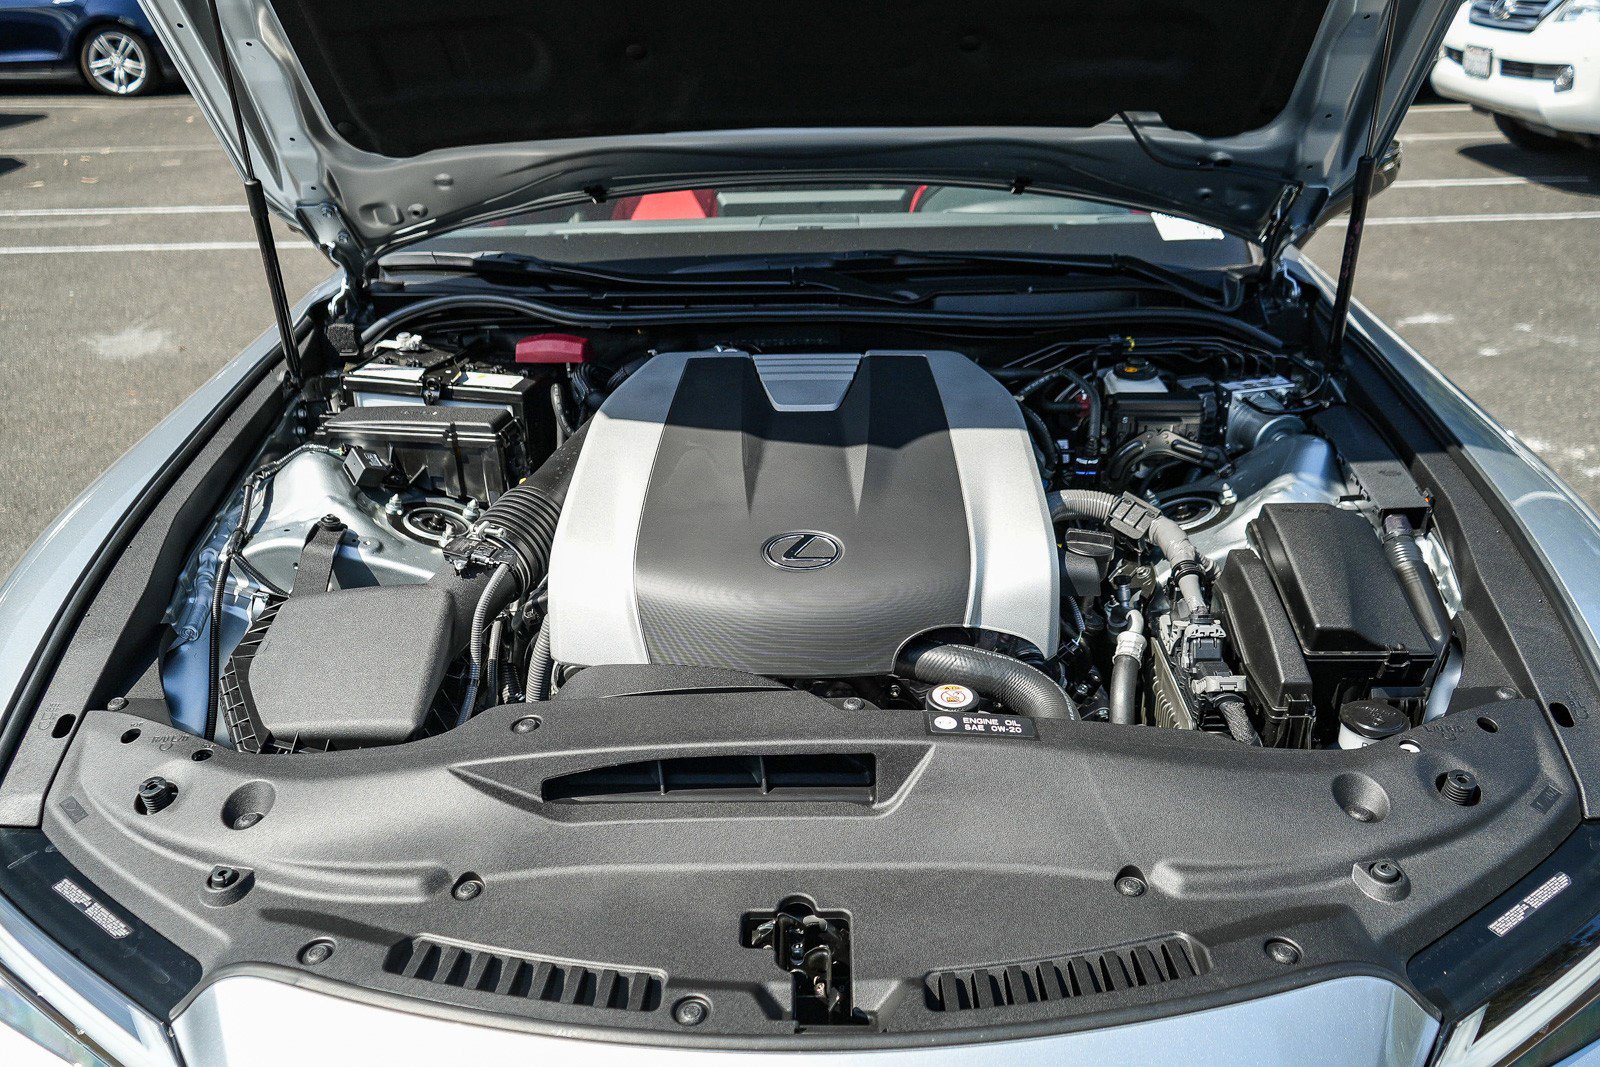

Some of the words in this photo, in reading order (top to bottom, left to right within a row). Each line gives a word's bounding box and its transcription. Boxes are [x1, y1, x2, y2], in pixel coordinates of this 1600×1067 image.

[962, 717, 999, 726] ENGINE
[1004, 719, 1022, 727] OIL
[964, 724, 985, 732] SAE
[990, 725, 1022, 734] 0W-20
